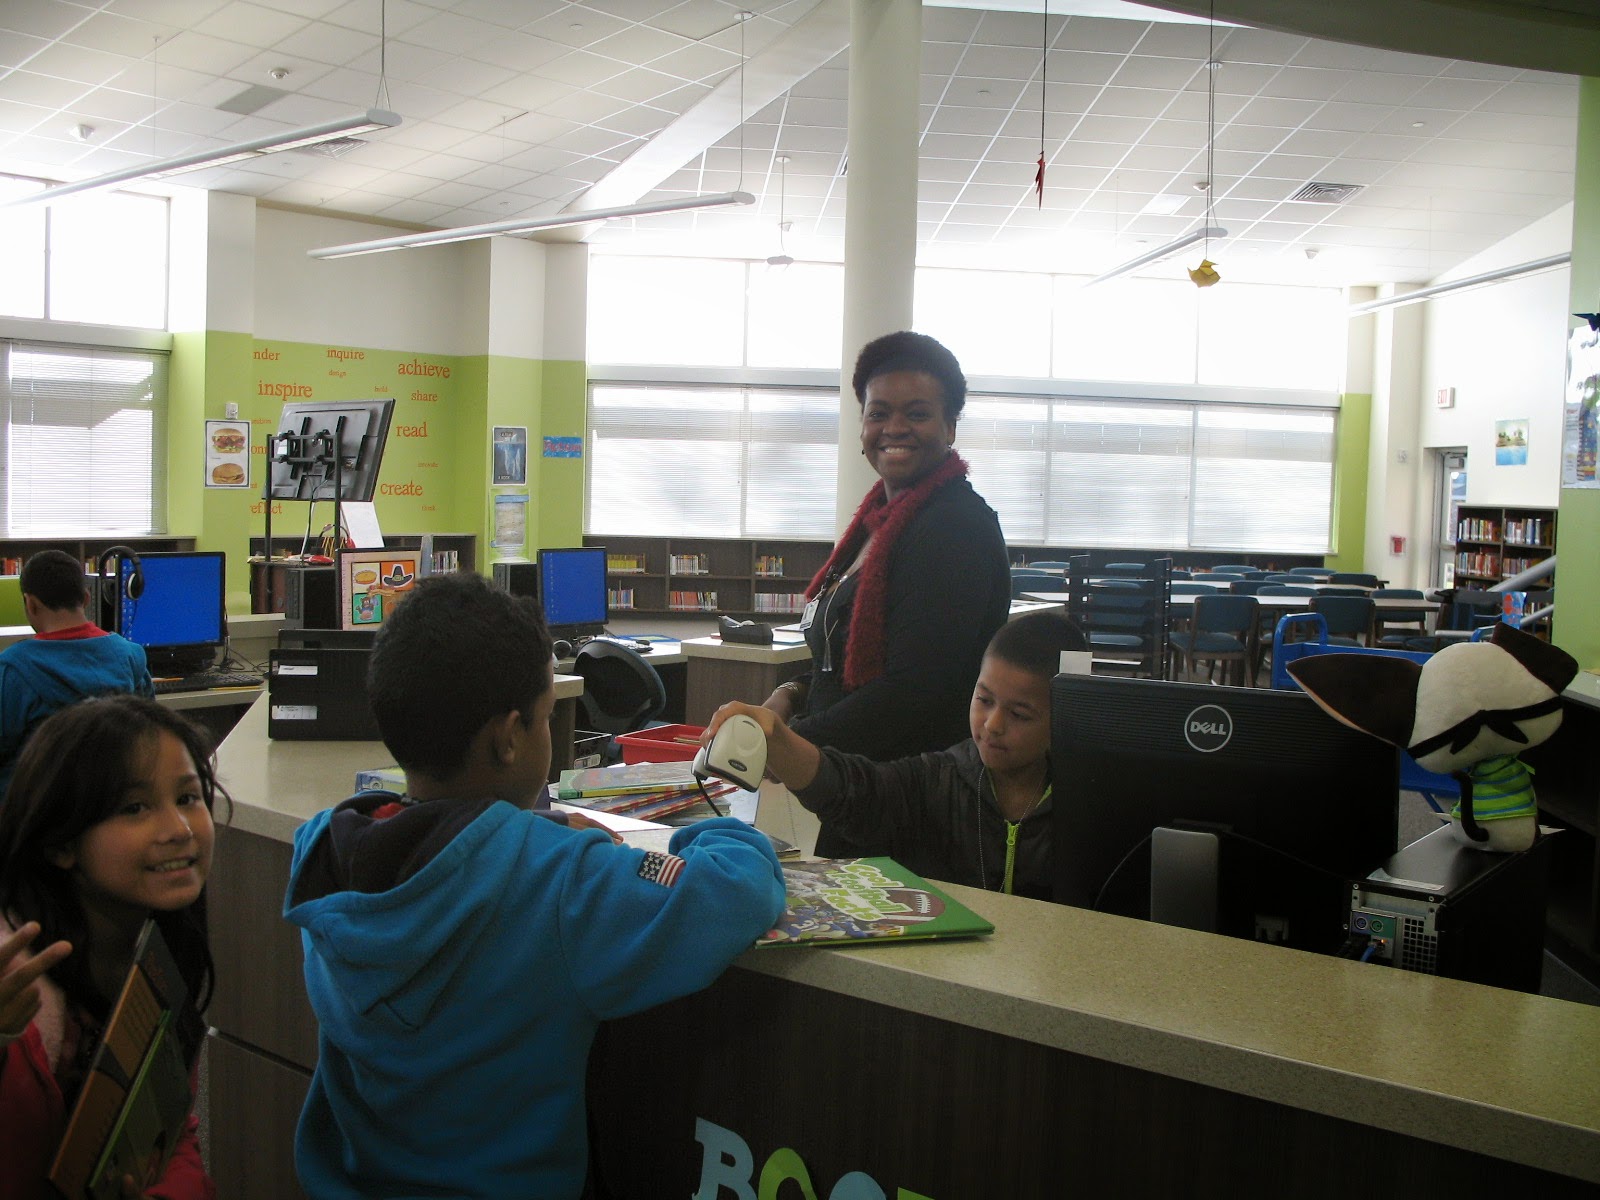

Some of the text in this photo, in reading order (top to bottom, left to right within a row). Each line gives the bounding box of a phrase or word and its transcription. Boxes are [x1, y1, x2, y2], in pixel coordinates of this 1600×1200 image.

[327, 348, 365, 362] inquire
[398, 358, 451, 378] achieve
[258, 380, 313, 401] inspire
[411, 389, 438, 402] share
[396, 421, 428, 437] read
[380, 480, 423, 497] create
[1190, 721, 1226, 735] DELL
[841, 864, 904, 888] Cool
[826, 873, 911, 913] Football
[815, 888, 887, 921] Facts
